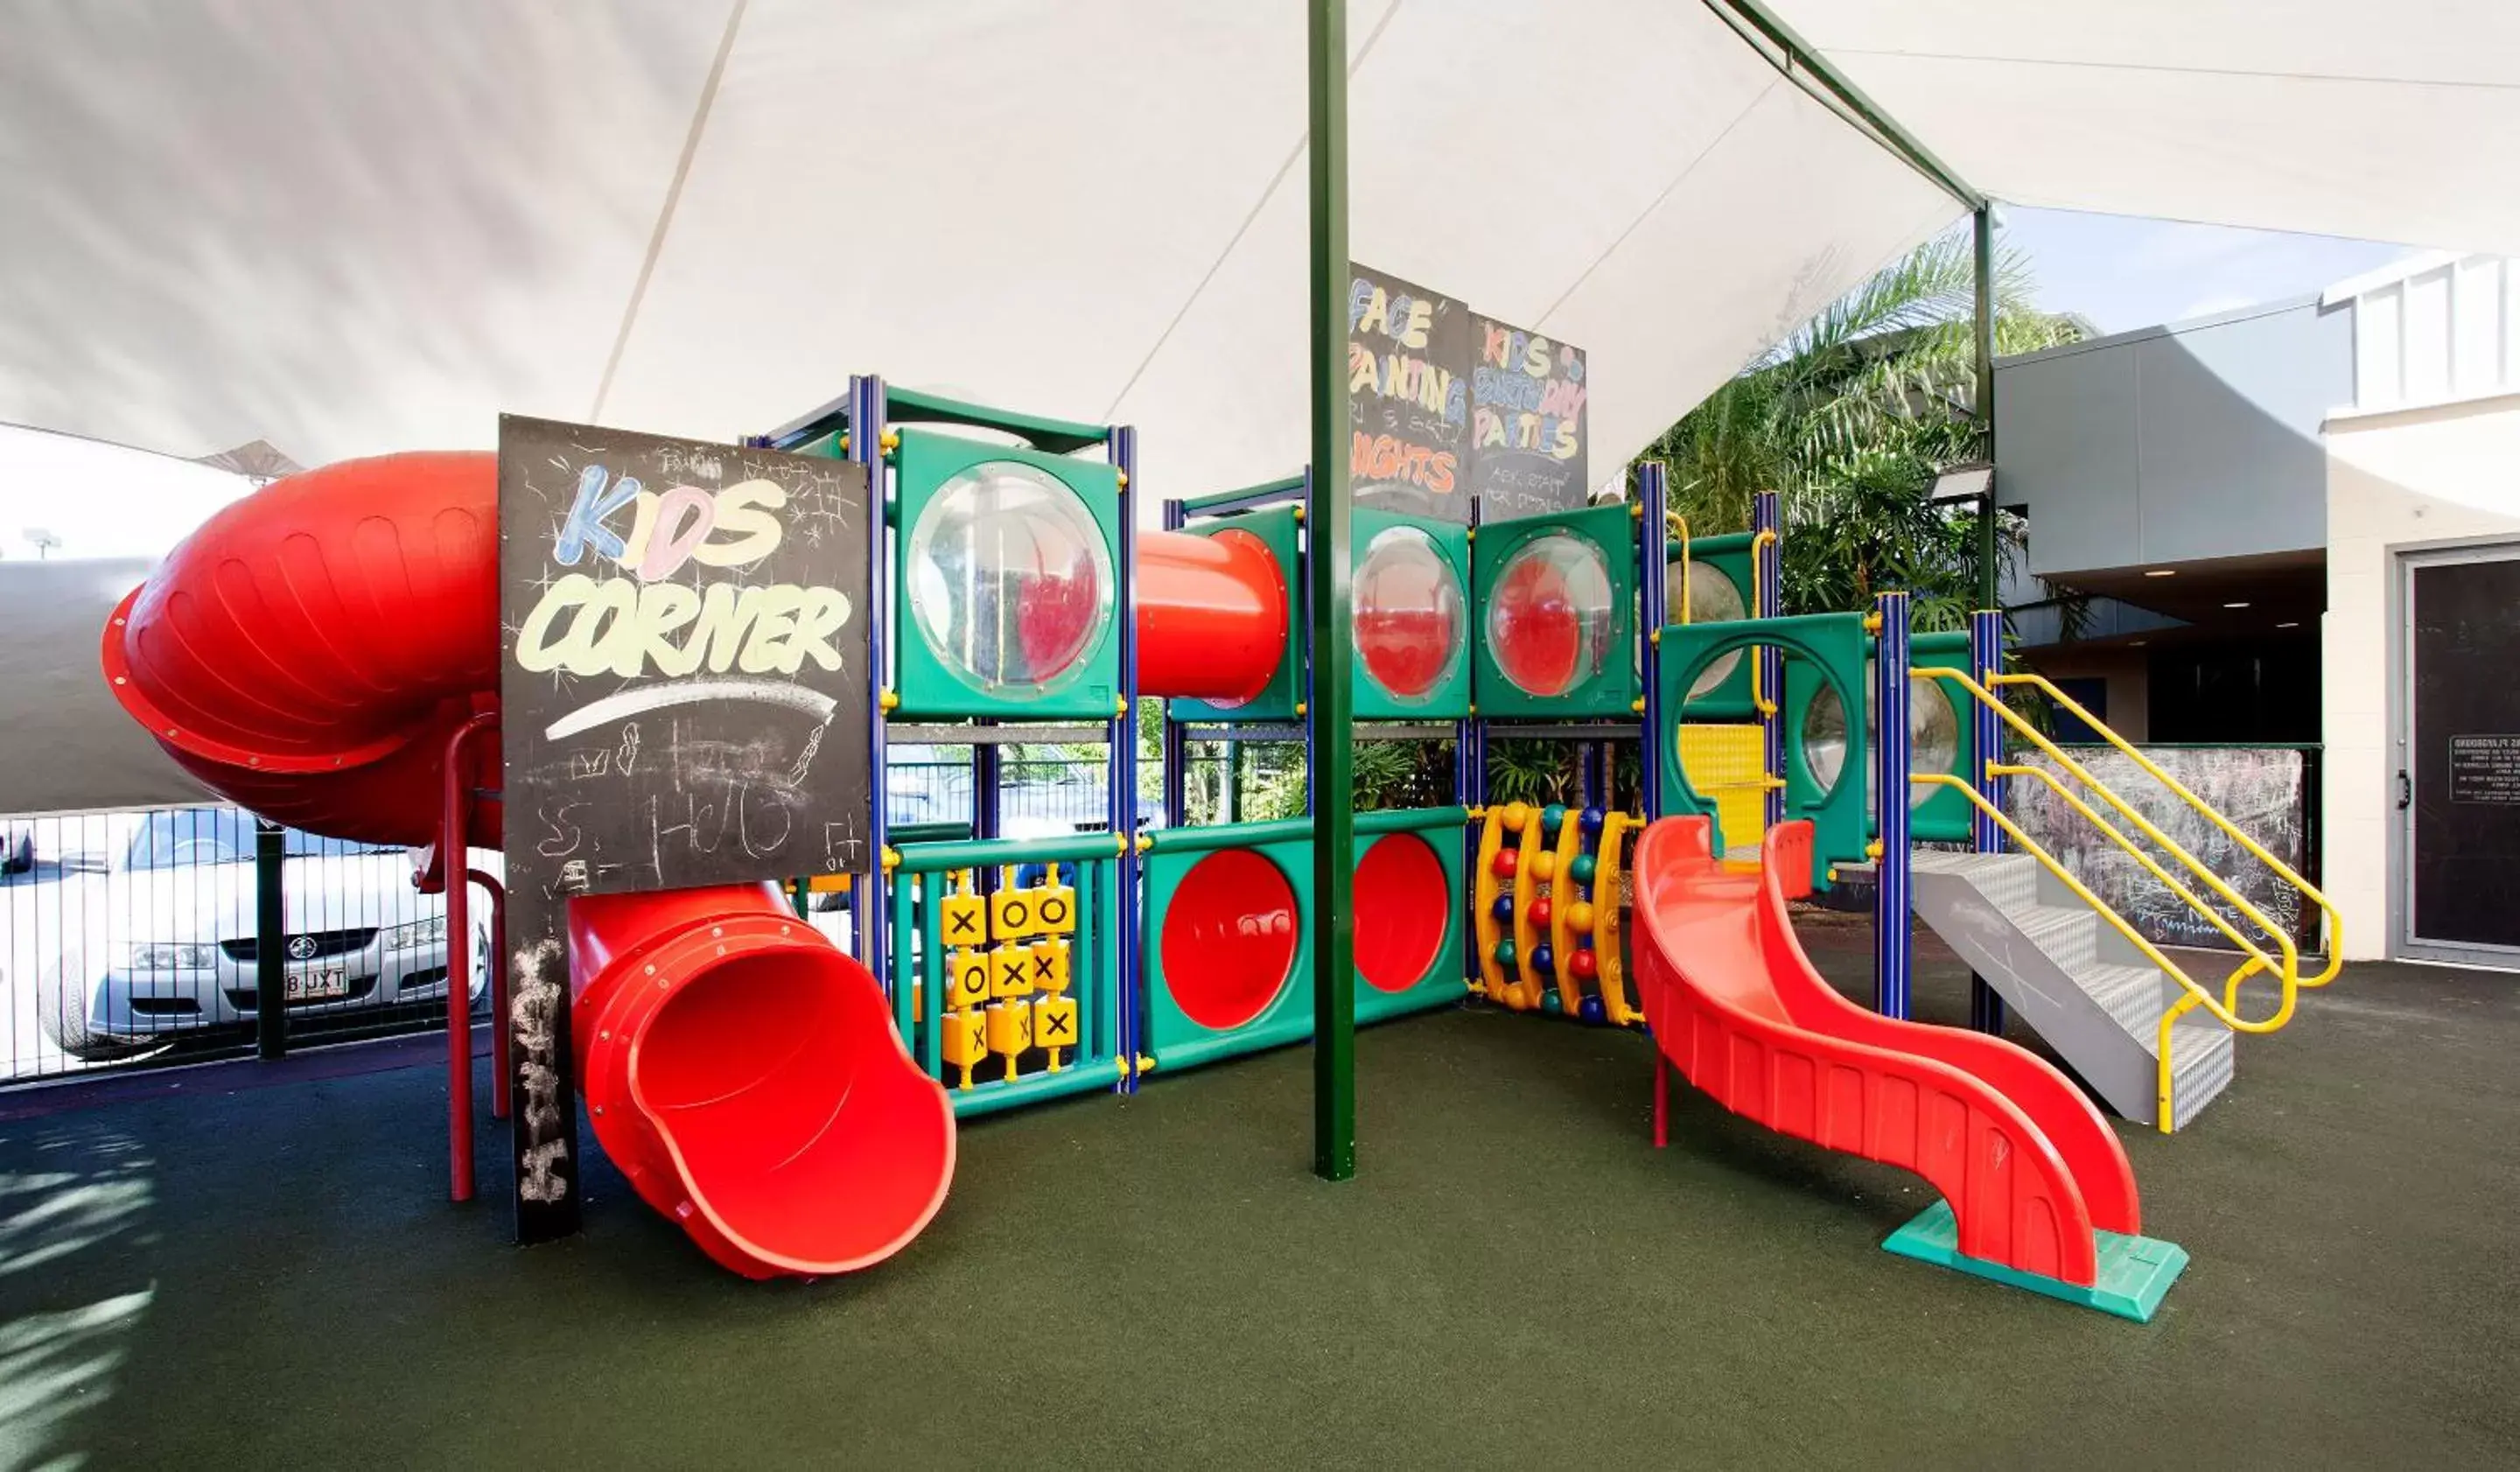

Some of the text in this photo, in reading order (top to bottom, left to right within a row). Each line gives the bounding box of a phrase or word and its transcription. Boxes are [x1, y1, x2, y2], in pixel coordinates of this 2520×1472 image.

[1349, 277, 1432, 348] FACE
[1483, 322, 1551, 377] KIDS
[553, 464, 788, 582] KIDS
[515, 572, 853, 678] CORNER
